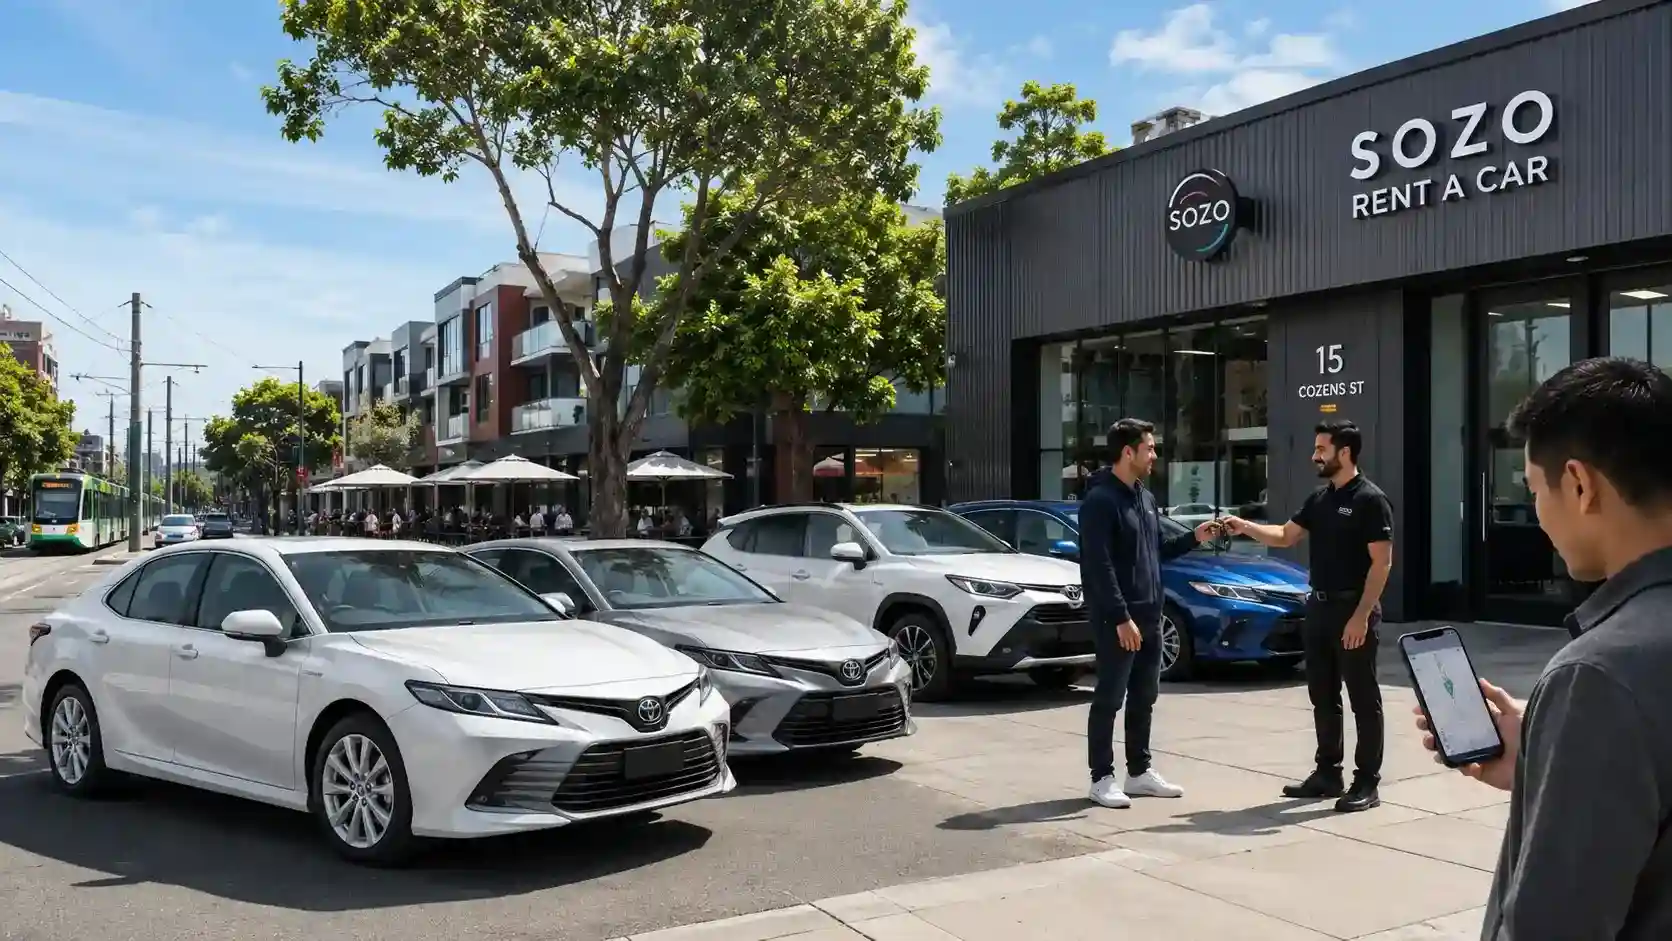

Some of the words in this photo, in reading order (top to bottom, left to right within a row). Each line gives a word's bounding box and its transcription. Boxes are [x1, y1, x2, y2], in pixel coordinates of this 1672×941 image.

[1350, 90, 1553, 180] SOZO
[1352, 178, 1432, 219] RENT
[1442, 174, 1465, 201] A
[1476, 155, 1548, 193] CAR
[1169, 199, 1230, 231] SOZO
[1316, 344, 1343, 374] 15
[1298, 382, 1346, 398] COZENS
[1349, 380, 1365, 395] ST
